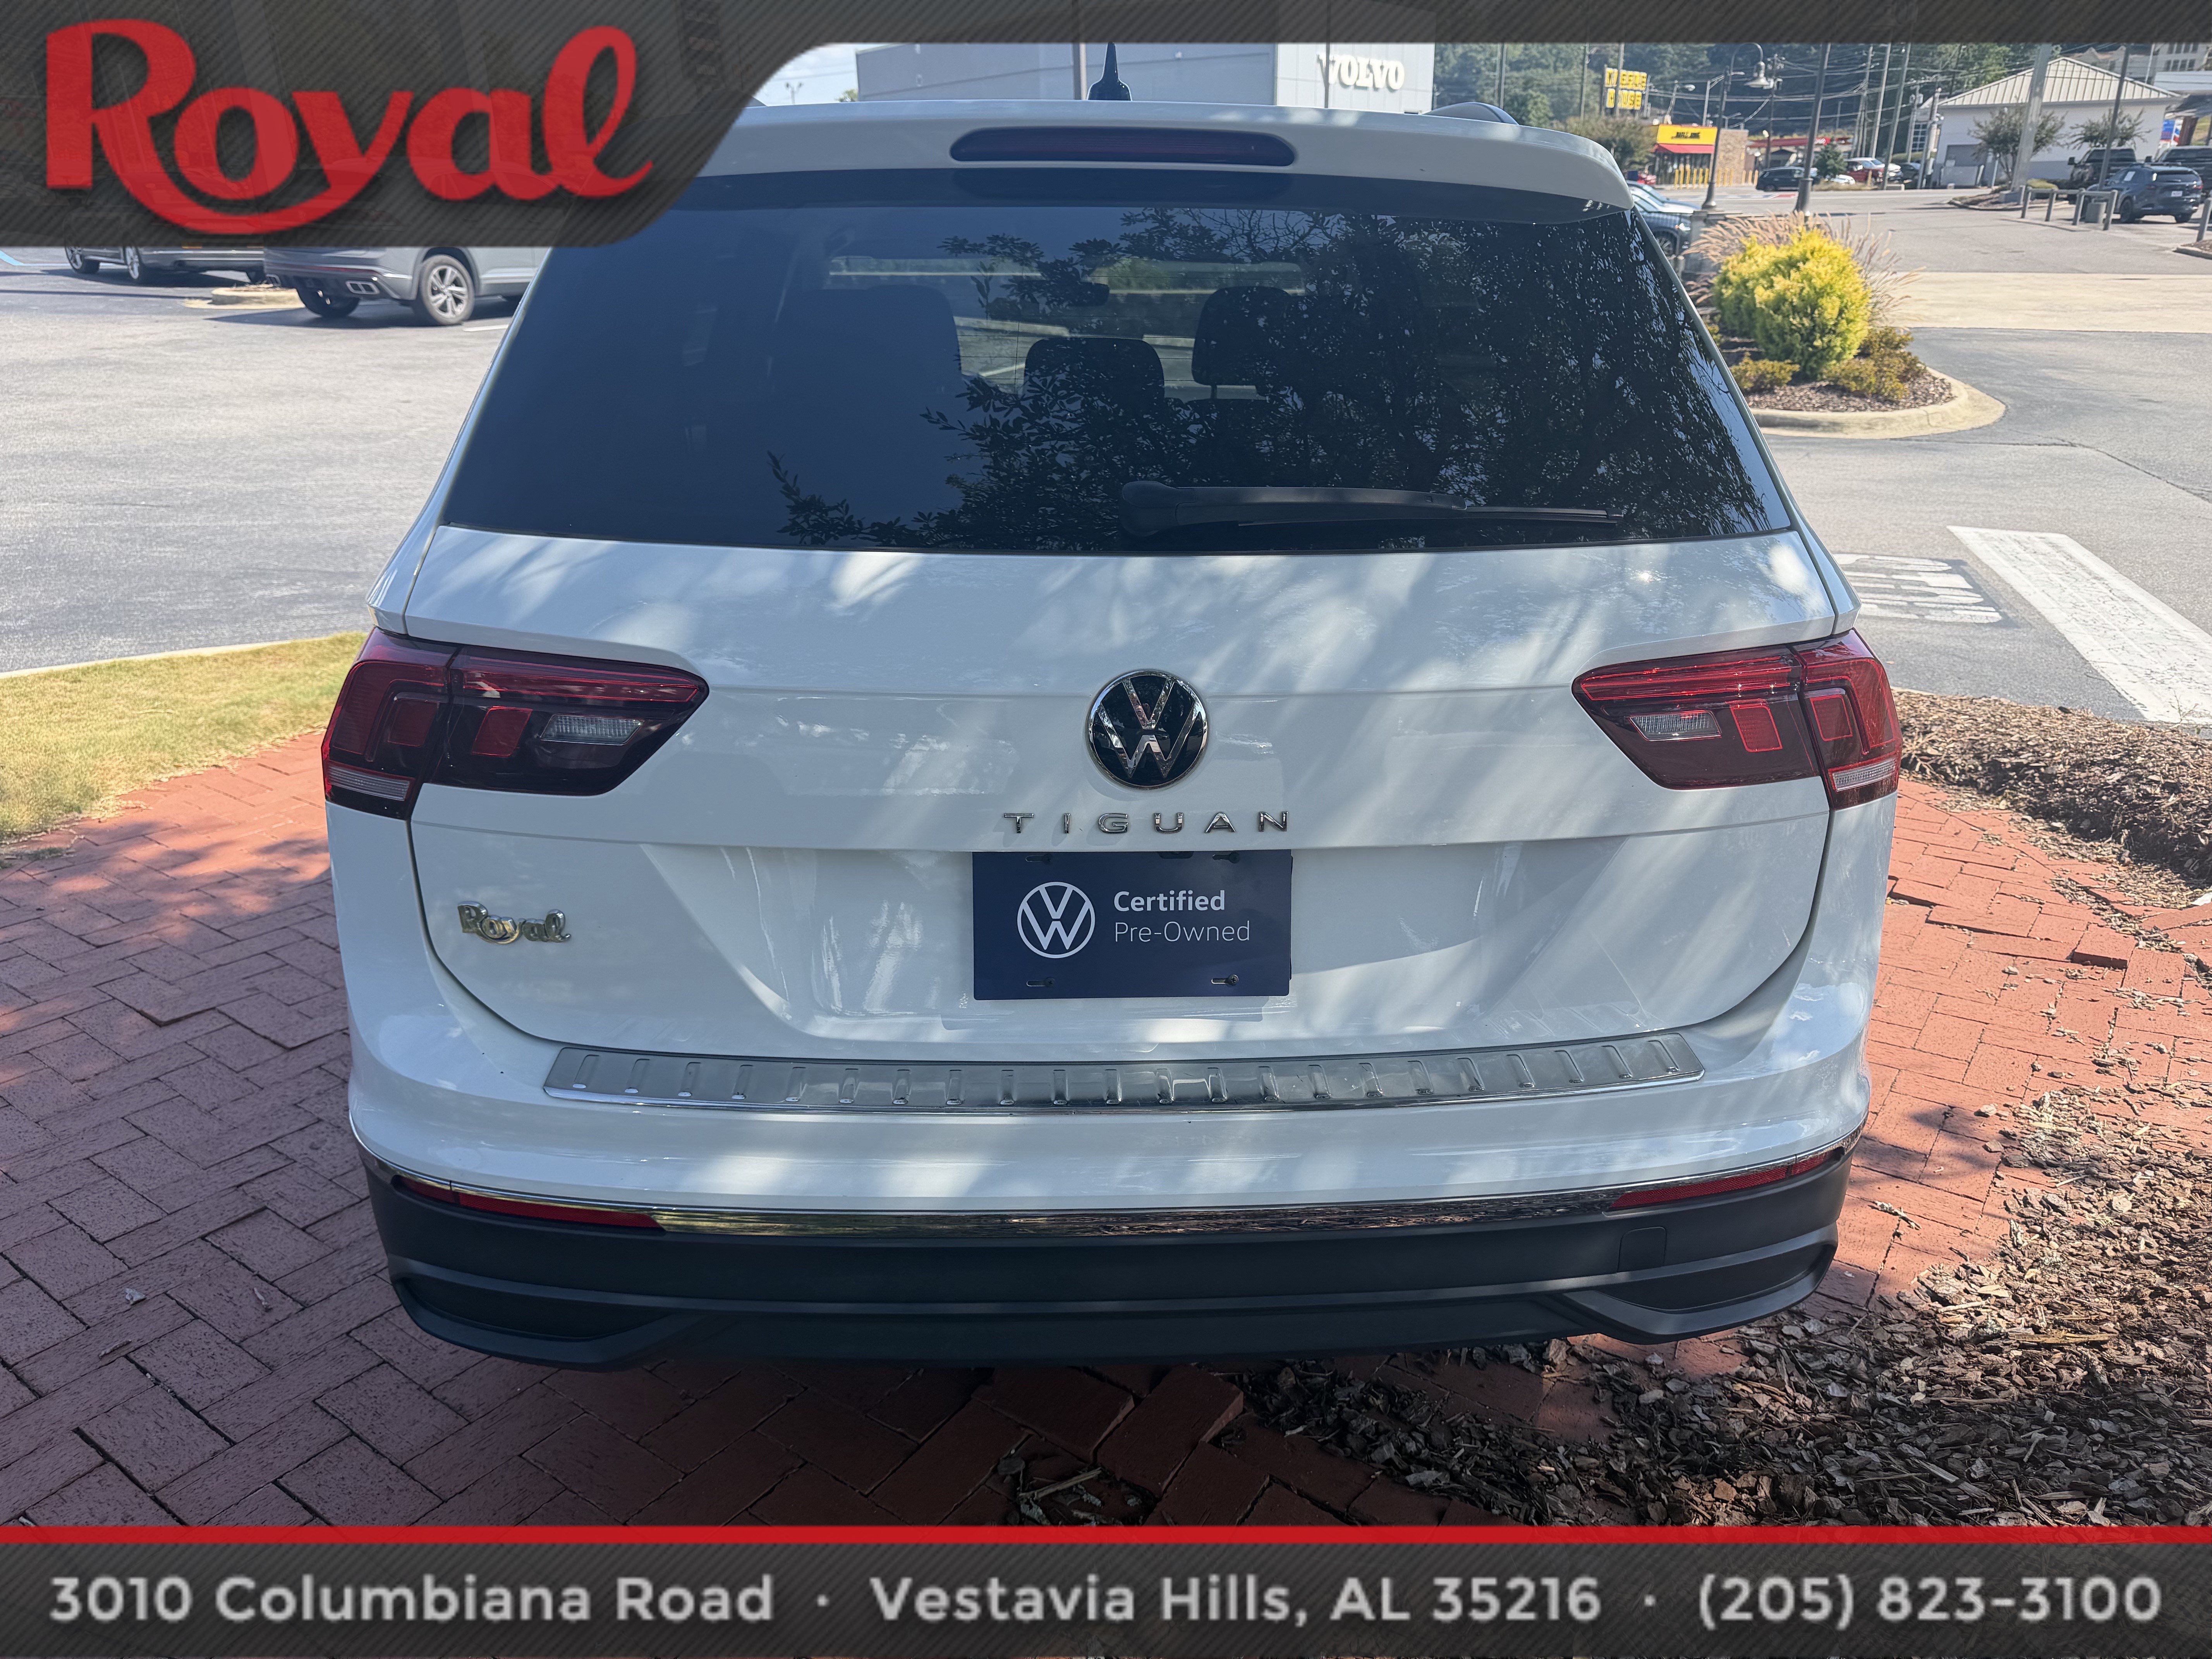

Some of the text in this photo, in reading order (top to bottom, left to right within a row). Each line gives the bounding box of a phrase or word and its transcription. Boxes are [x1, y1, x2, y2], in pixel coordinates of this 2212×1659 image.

[1316, 52, 1405, 90] VOLVO
[1003, 810, 1289, 834] TIGUAN
[1113, 890, 1226, 912] Certified
[457, 901, 572, 945] Royal
[1115, 920, 1251, 943] Pre-Owned
